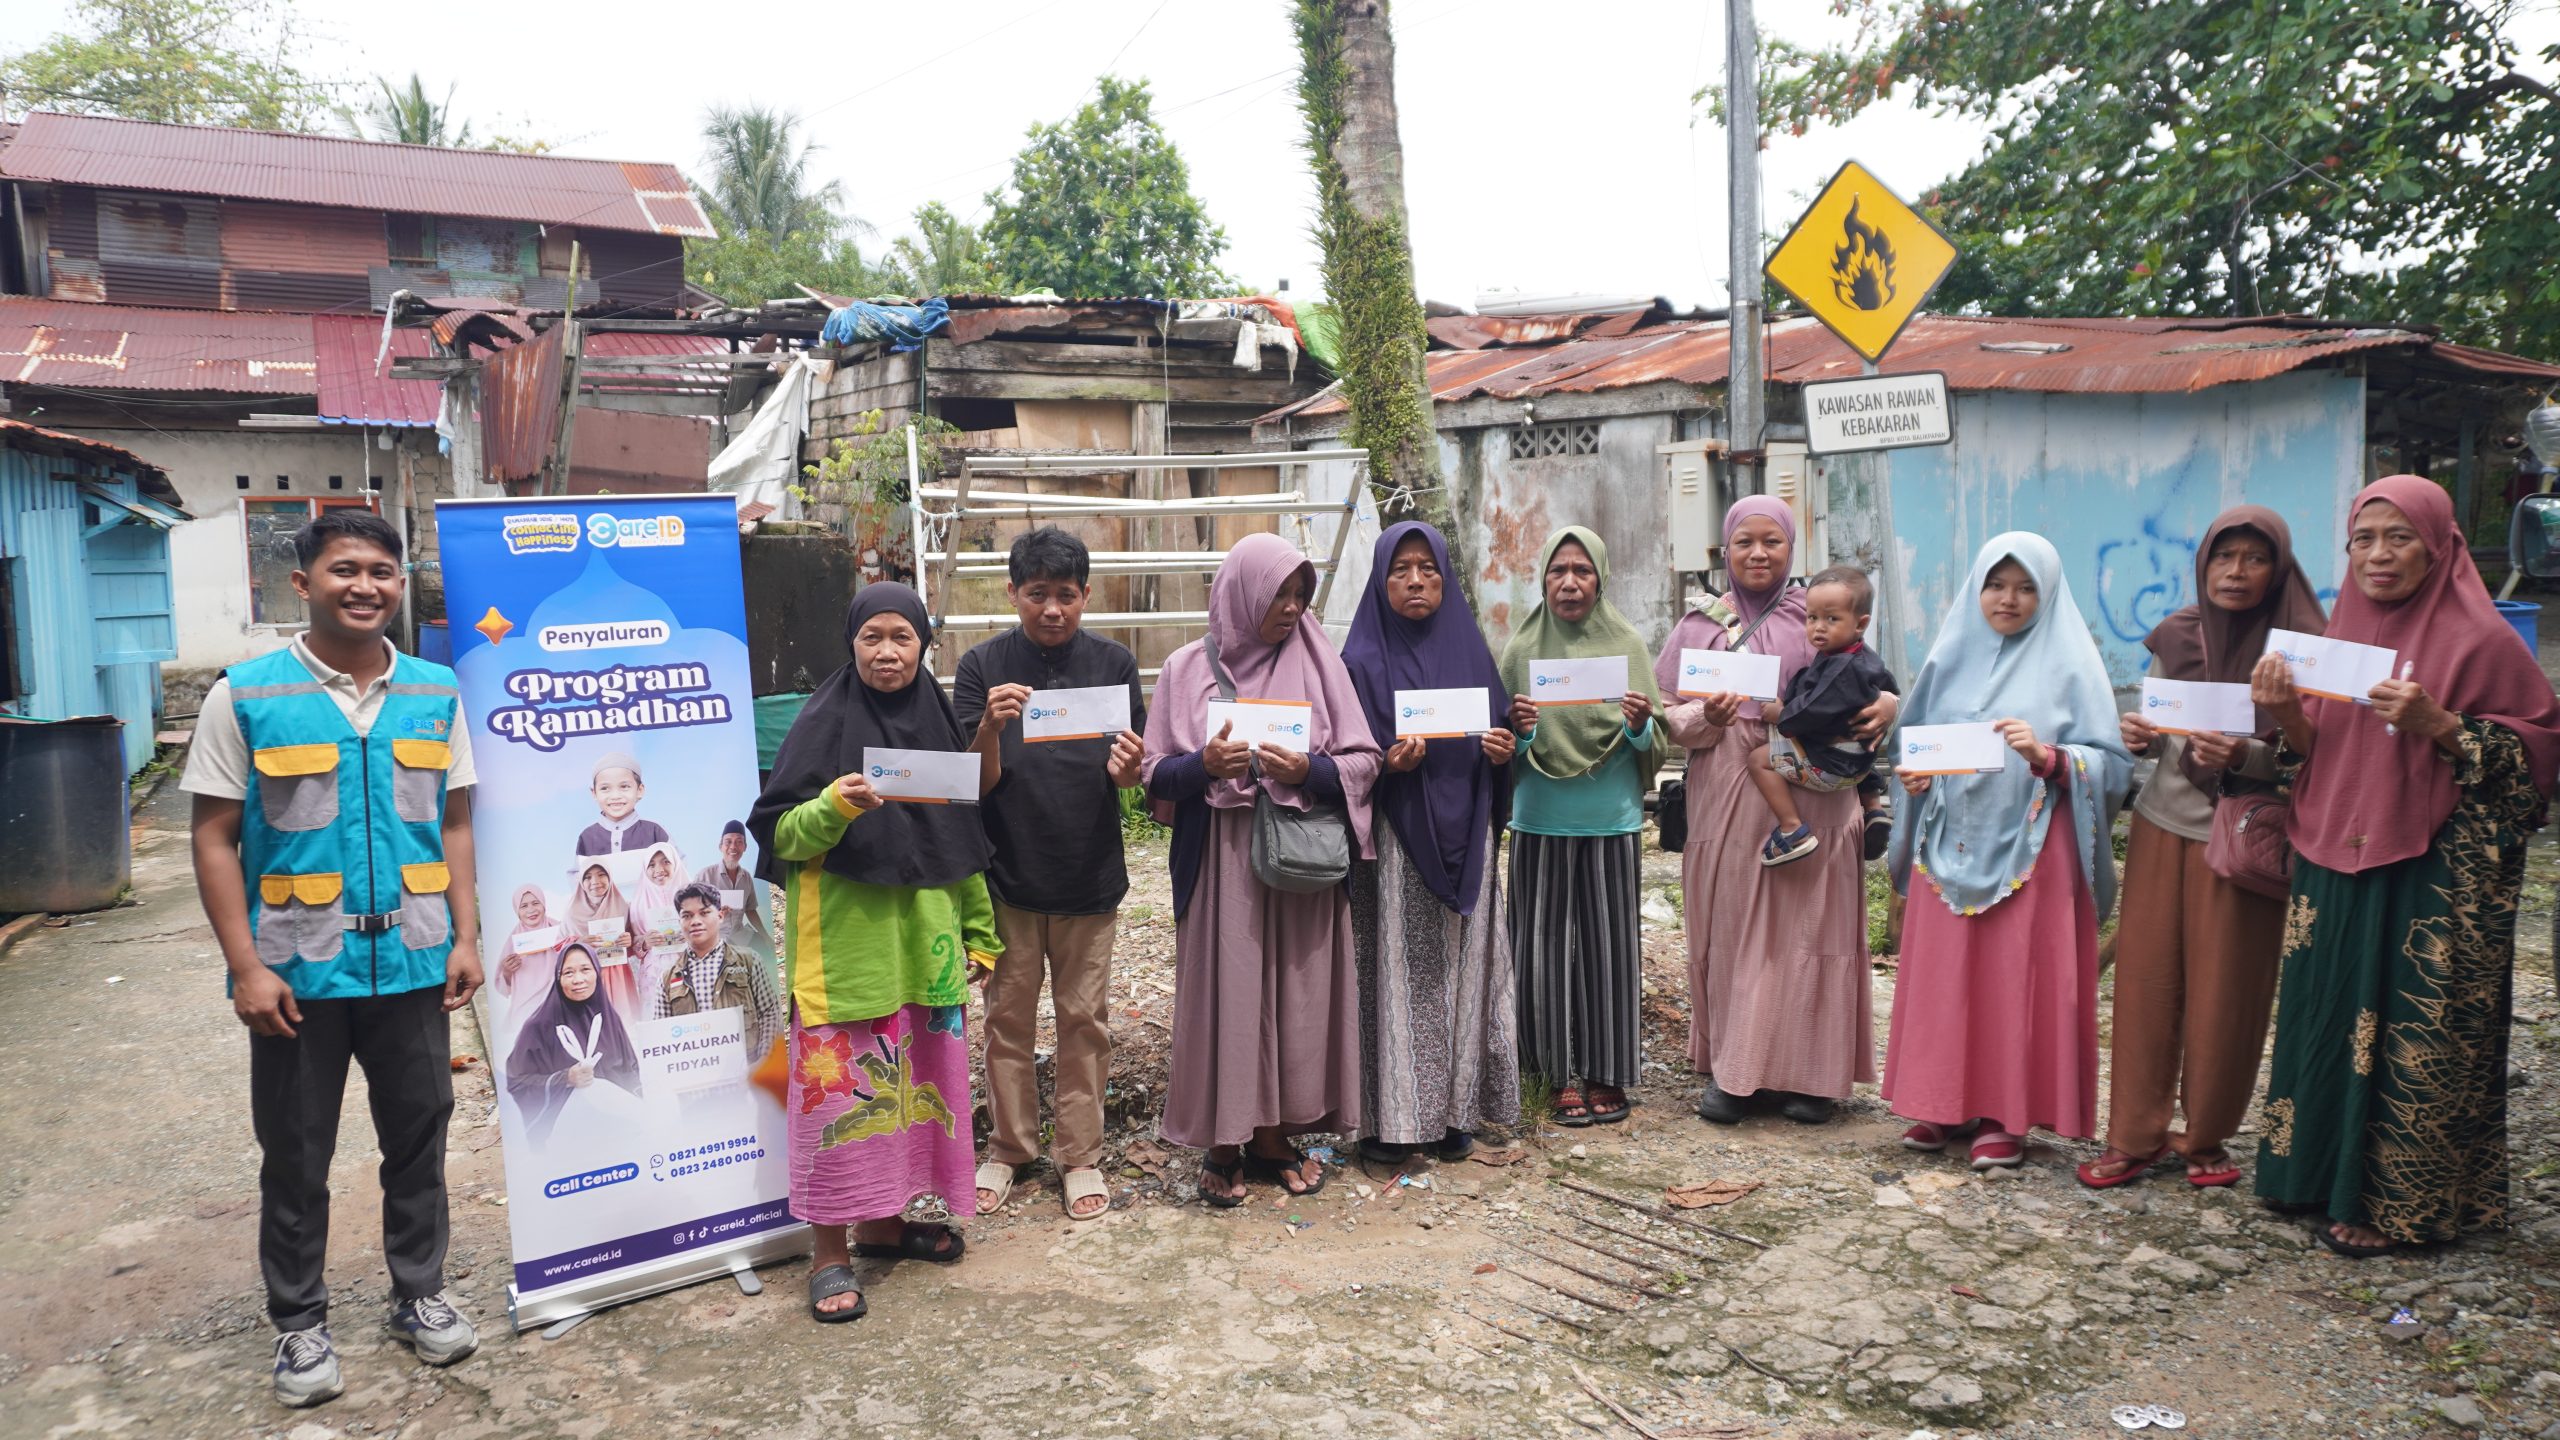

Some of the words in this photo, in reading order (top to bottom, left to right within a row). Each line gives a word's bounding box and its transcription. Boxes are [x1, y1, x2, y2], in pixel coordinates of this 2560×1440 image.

[1818, 392, 1883, 416] KAWASAN
[1888, 387, 1936, 407] RAWAN
[1841, 412, 1921, 437] KEBAKARAN
[545, 624, 664, 648] Penyaluran
[509, 665, 707, 704] Program
[492, 696, 728, 747] Ramadhan
[642, 1033, 740, 1059] PENYALURAN
[667, 1055, 721, 1074] FIDYAH
[669, 1147, 697, 1162] 0821
[699, 1142, 726, 1157] 4991
[727, 1135, 757, 1151] 9994
[670, 1163, 700, 1178] 0823
[702, 1156, 733, 1171] 2480
[734, 1148, 766, 1165] 0060
[548, 1177, 580, 1196] Call
[581, 1166, 635, 1188] Center
[712, 1208, 782, 1234] careid_official
[544, 1248, 622, 1277] www.careid.id
